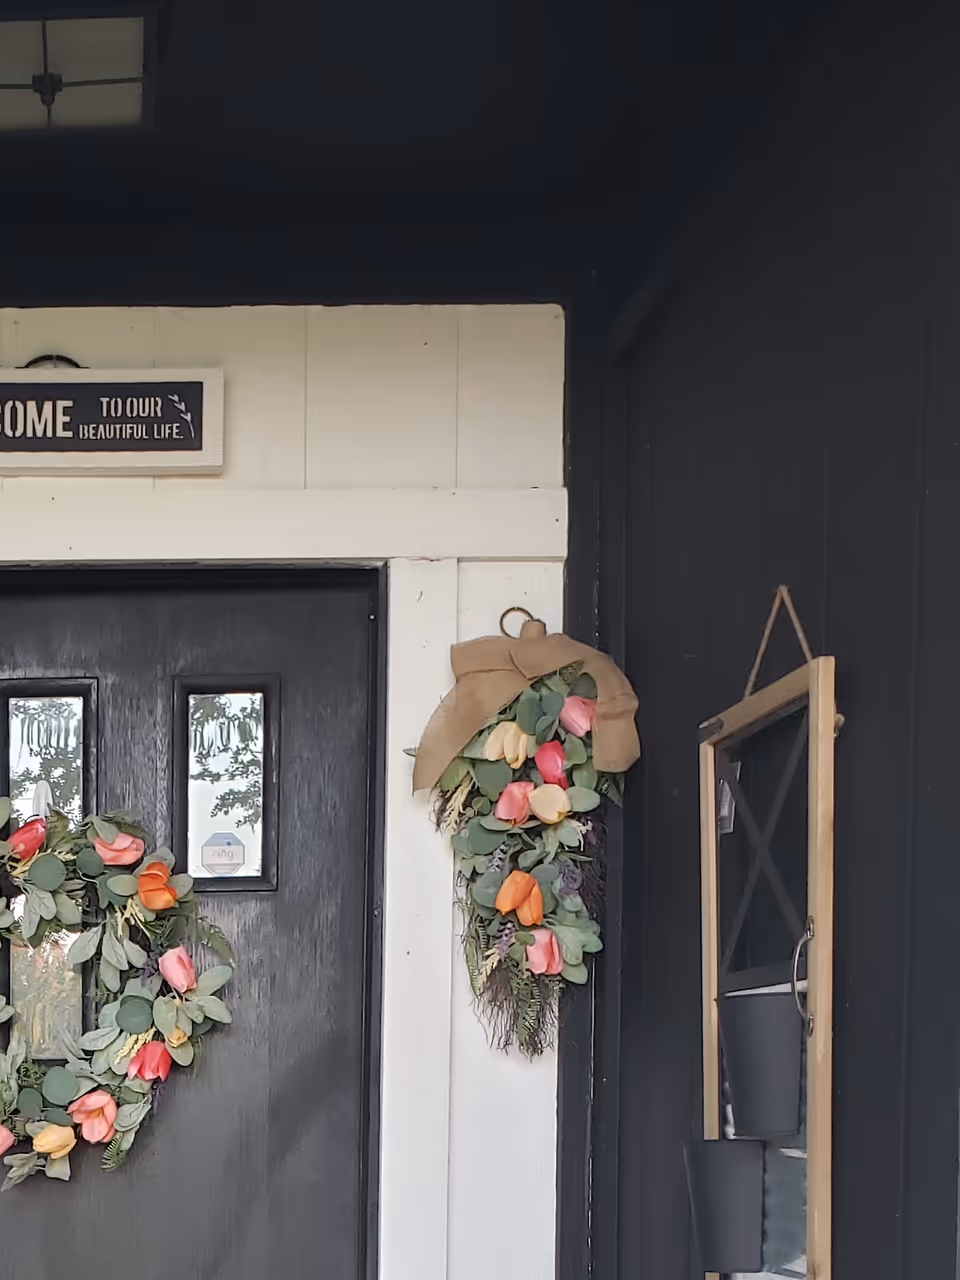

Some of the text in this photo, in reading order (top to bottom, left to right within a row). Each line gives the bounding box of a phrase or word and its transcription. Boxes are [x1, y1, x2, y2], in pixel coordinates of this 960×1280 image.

[100, 397, 162, 418] TO OUR
[79, 423, 184, 440] BEAUTIFUL LIFE.
